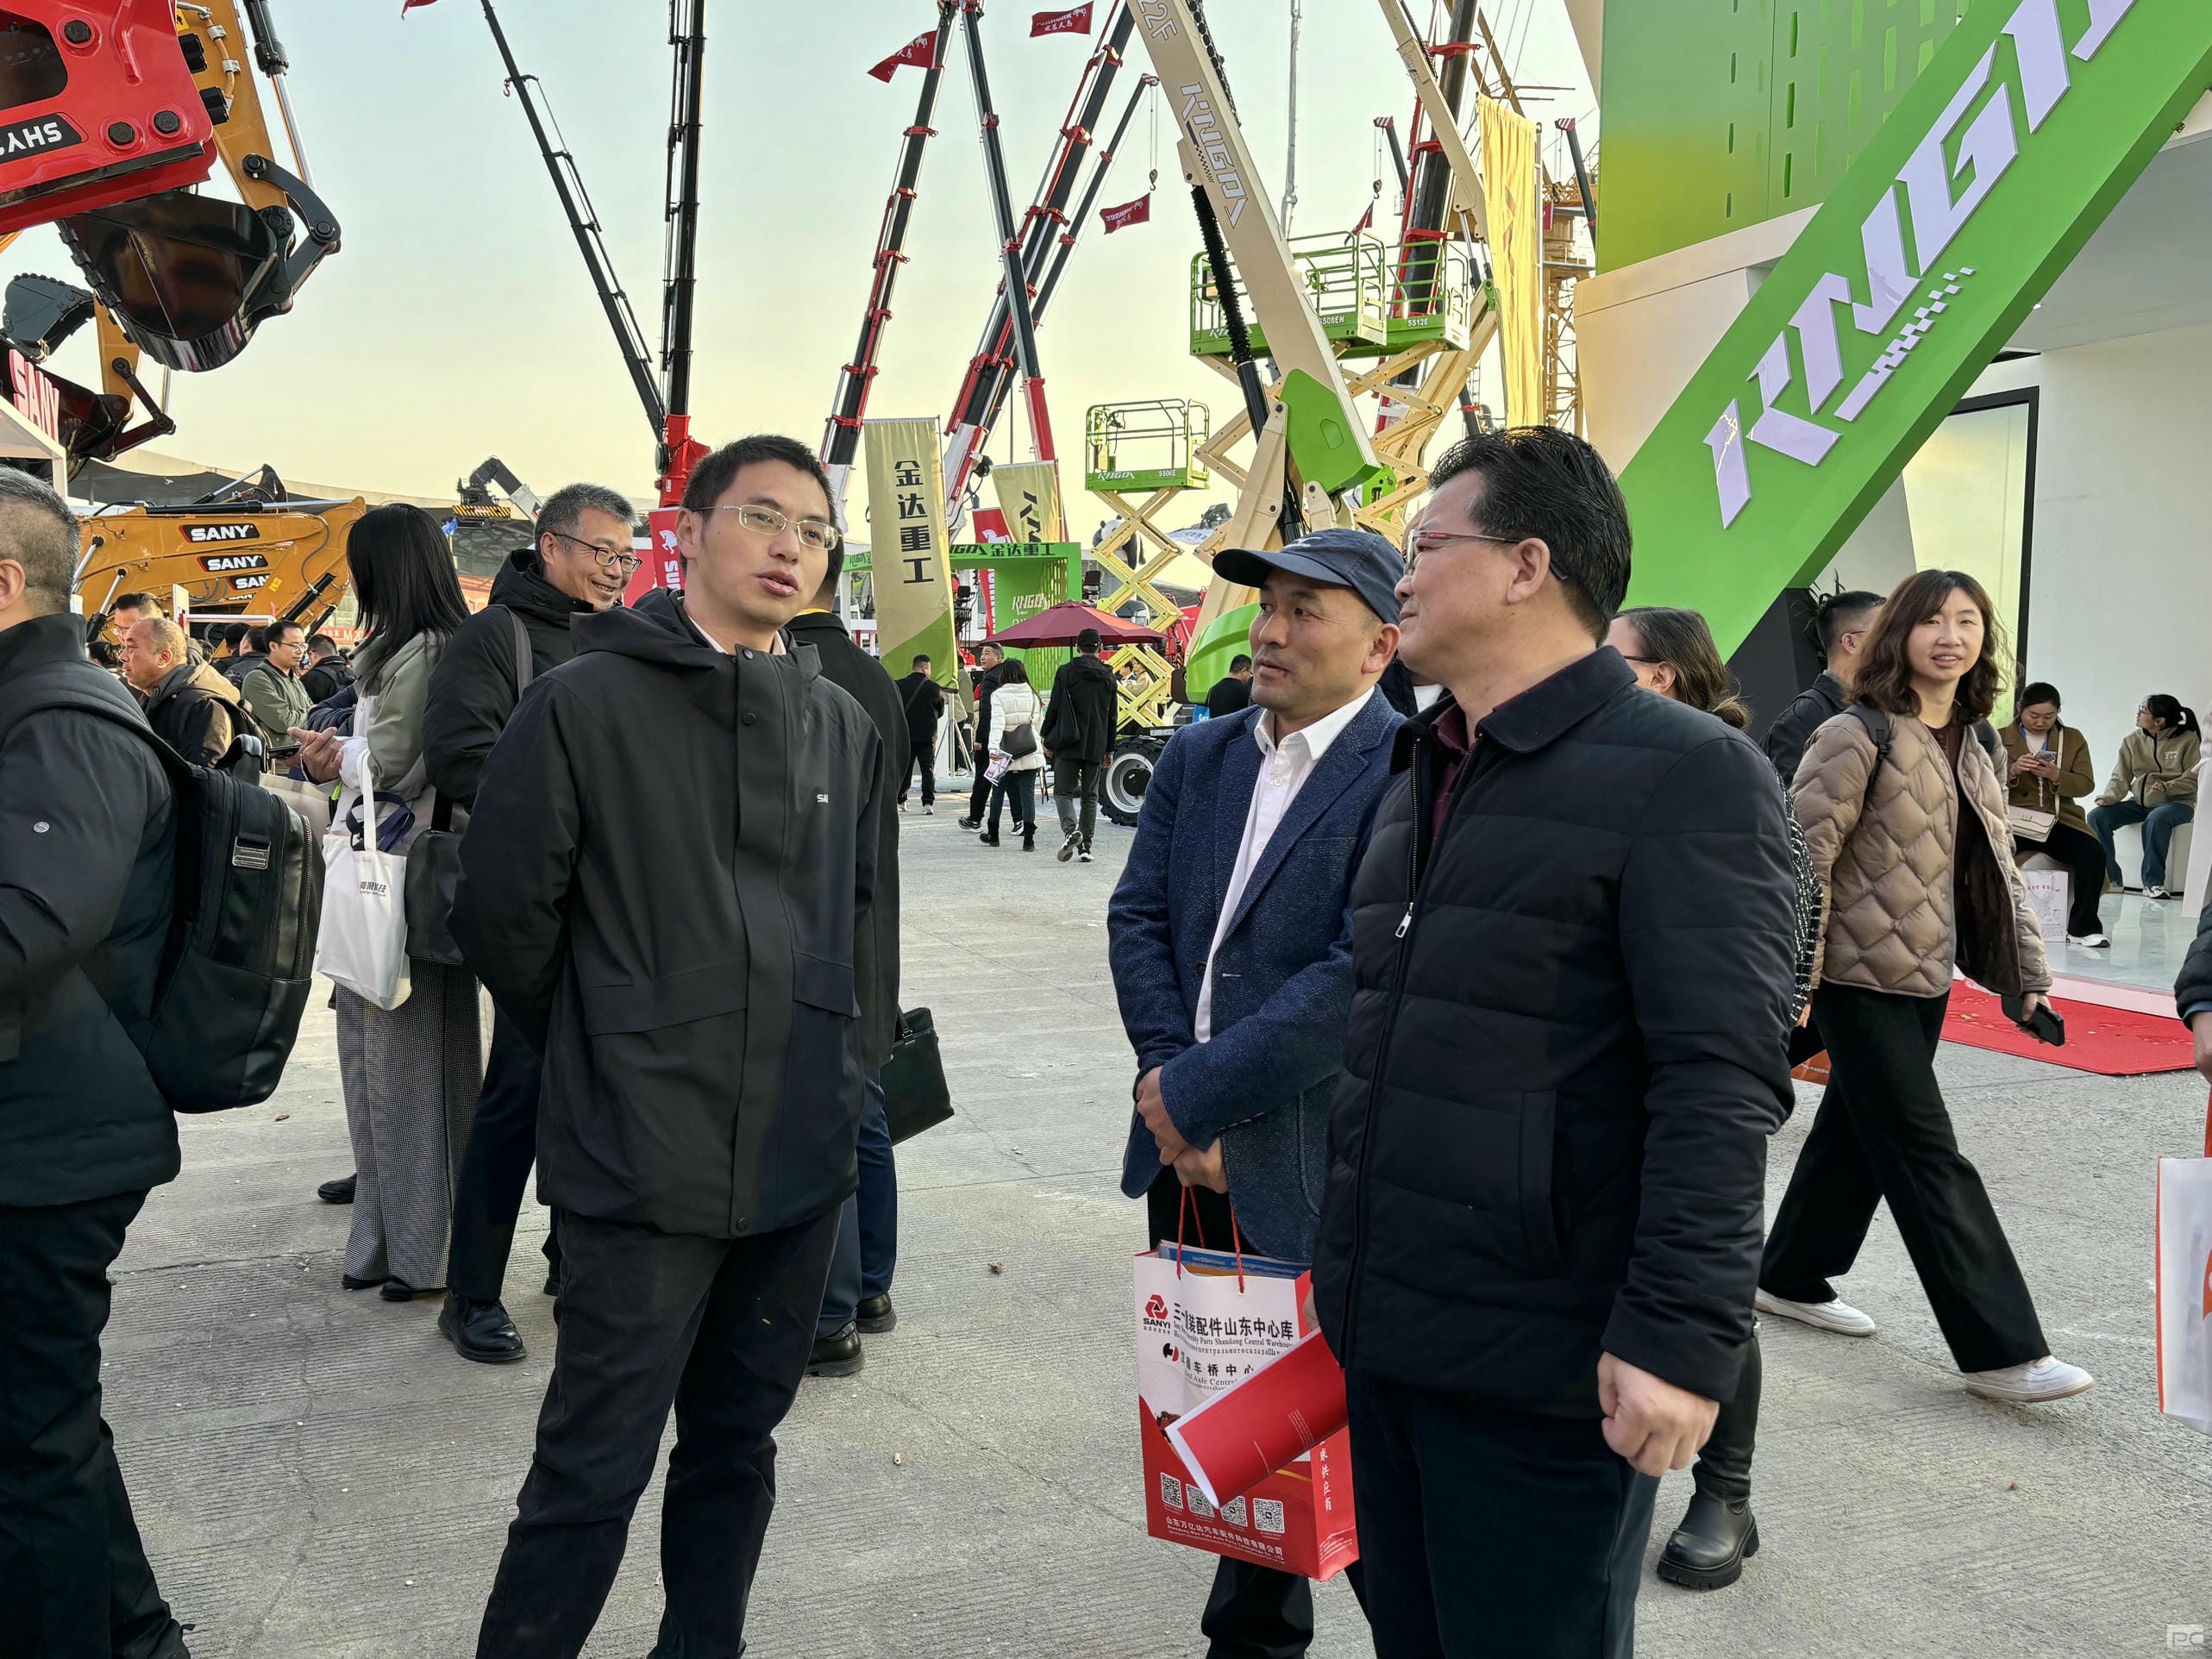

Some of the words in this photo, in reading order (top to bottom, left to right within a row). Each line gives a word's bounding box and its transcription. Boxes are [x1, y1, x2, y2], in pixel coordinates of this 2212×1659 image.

[1407, 318, 1429, 327] SS12E
[9, 348, 60, 445] SANY
[894, 460, 935, 585] 金达重工
[191, 524, 249, 542] SANY
[991, 543, 1056, 557] 金达重工
[207, 555, 259, 572] SANY
[1143, 1318, 1171, 1330] SANYI
